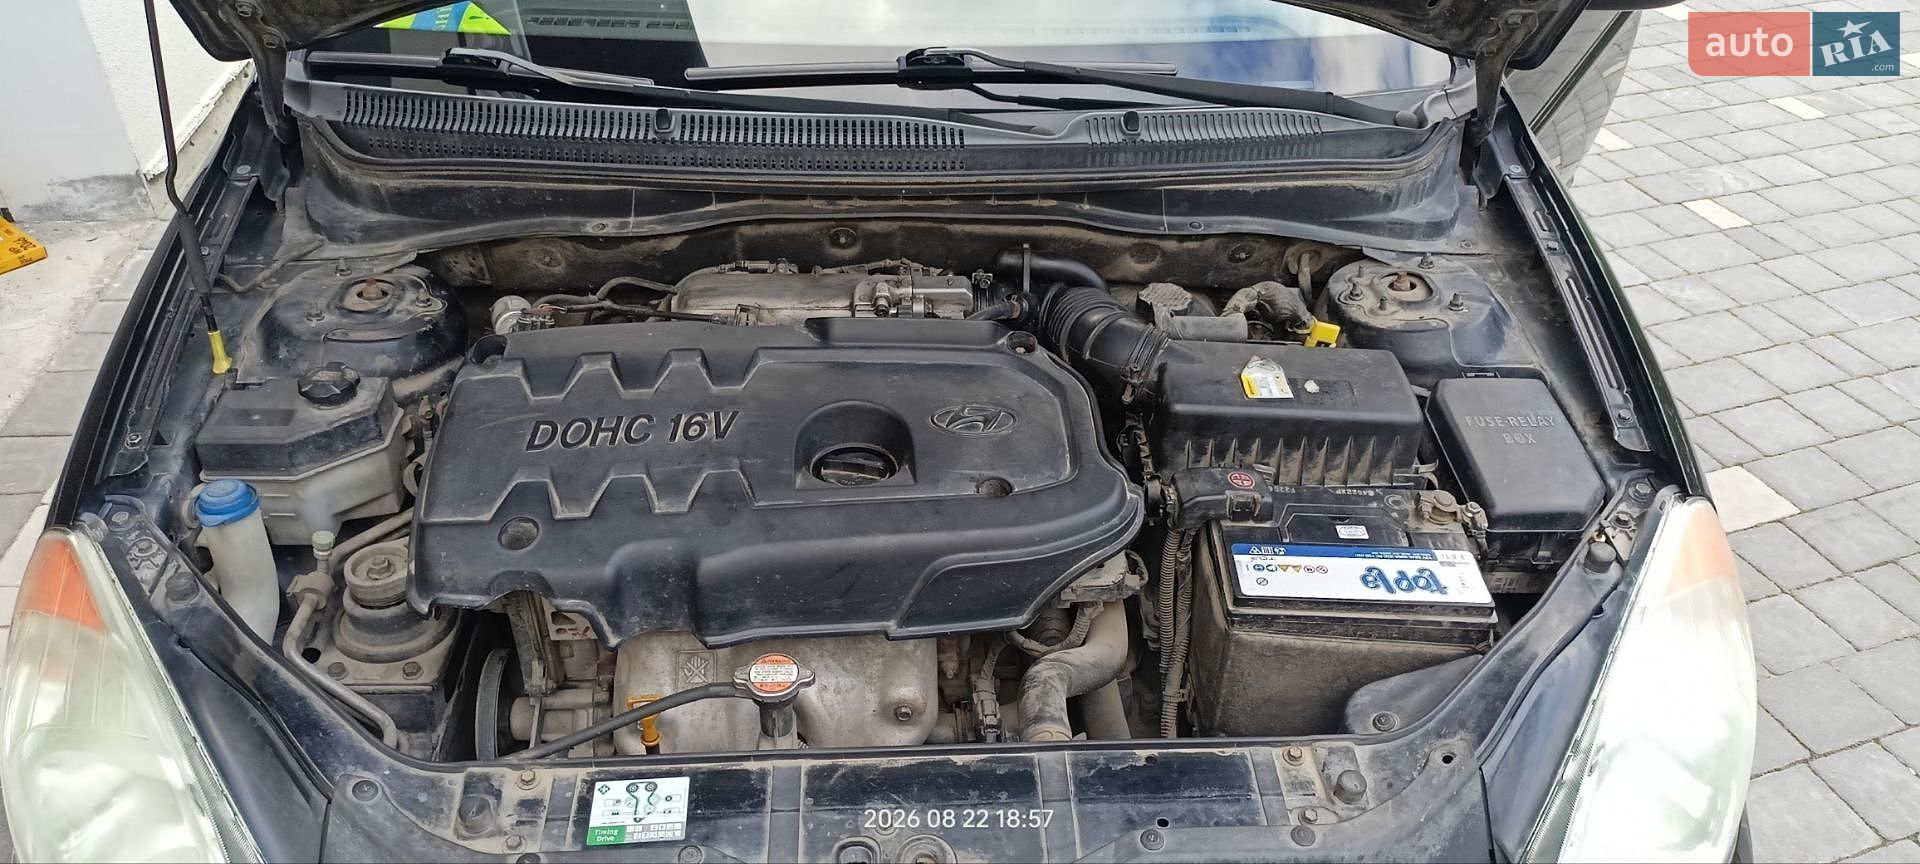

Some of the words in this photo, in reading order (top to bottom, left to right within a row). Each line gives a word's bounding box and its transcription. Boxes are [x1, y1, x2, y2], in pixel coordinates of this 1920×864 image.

[526, 414, 655, 451] DOHC
[668, 410, 739, 443] 16V
[1502, 432, 1537, 444] BOX
[1360, 566, 1448, 595] topla
[595, 829, 619, 837] Timing
